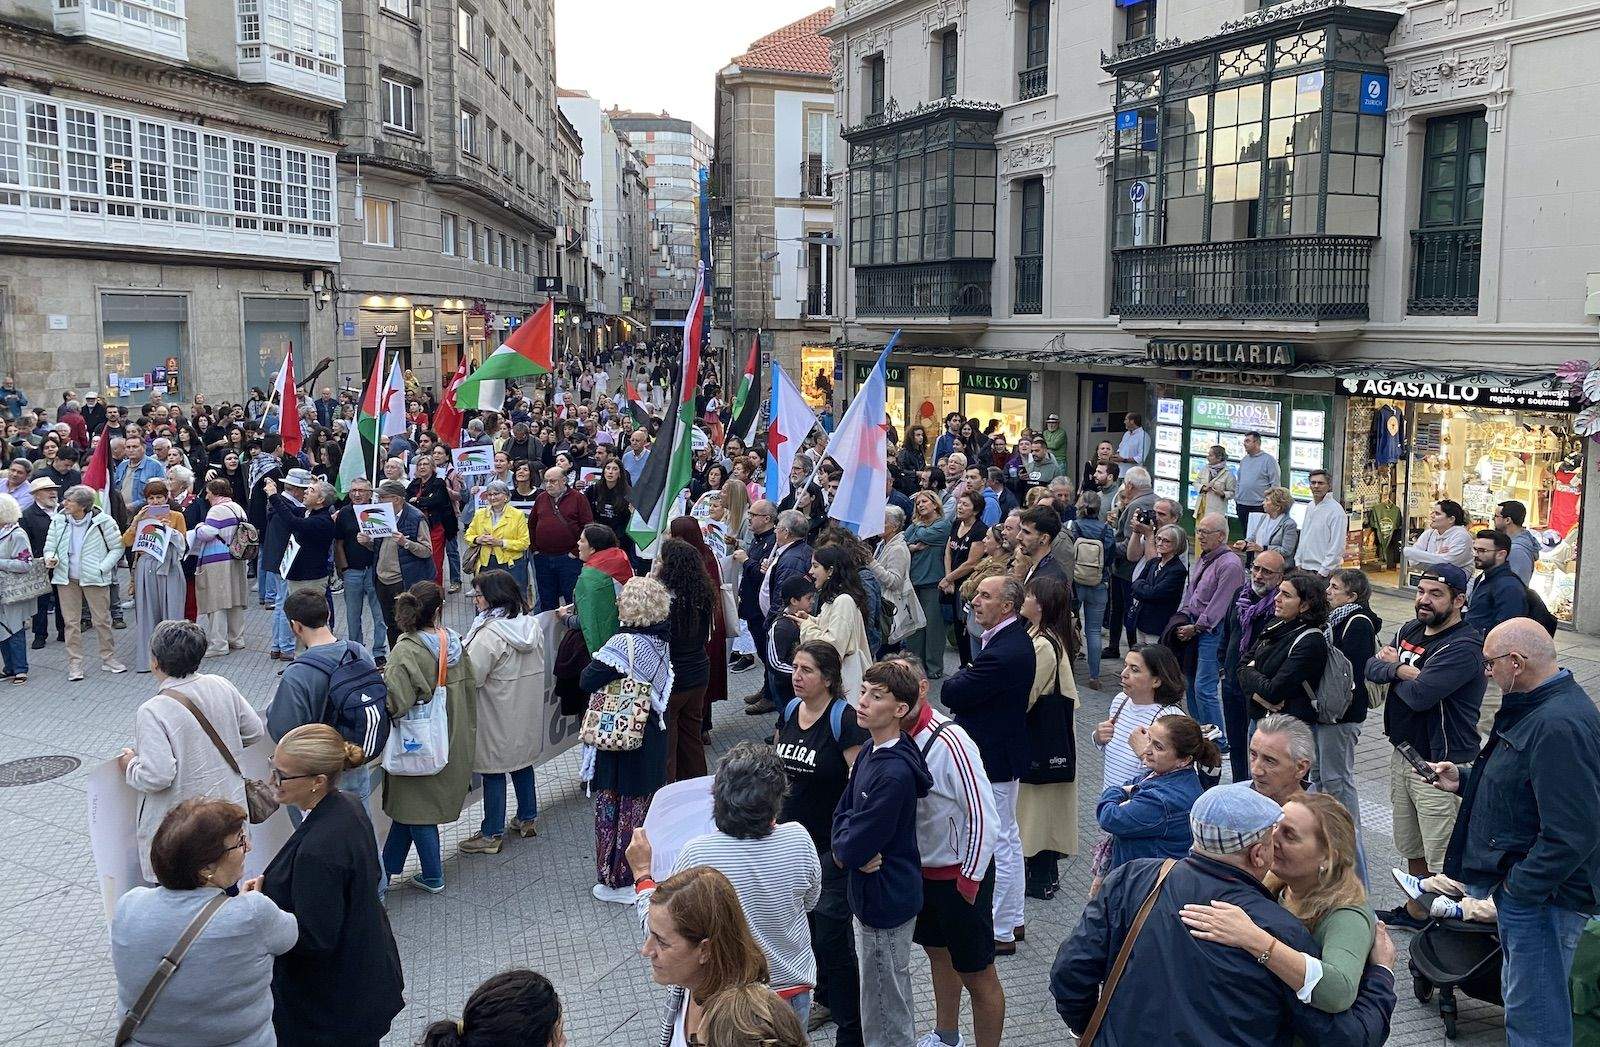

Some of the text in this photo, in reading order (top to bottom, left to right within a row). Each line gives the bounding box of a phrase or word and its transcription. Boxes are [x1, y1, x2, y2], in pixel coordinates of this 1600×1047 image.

[1364, 98, 1383, 106] ZURICH
[1145, 342, 1290, 365] INMOBILIARIA
[967, 374, 1020, 391] ARESSO
[1362, 379, 1479, 401] AGASALLO
[1489, 395, 1515, 404] regalo
[1527, 397, 1570, 407] souvenirs
[1207, 402, 1271, 420] PEDROSA
